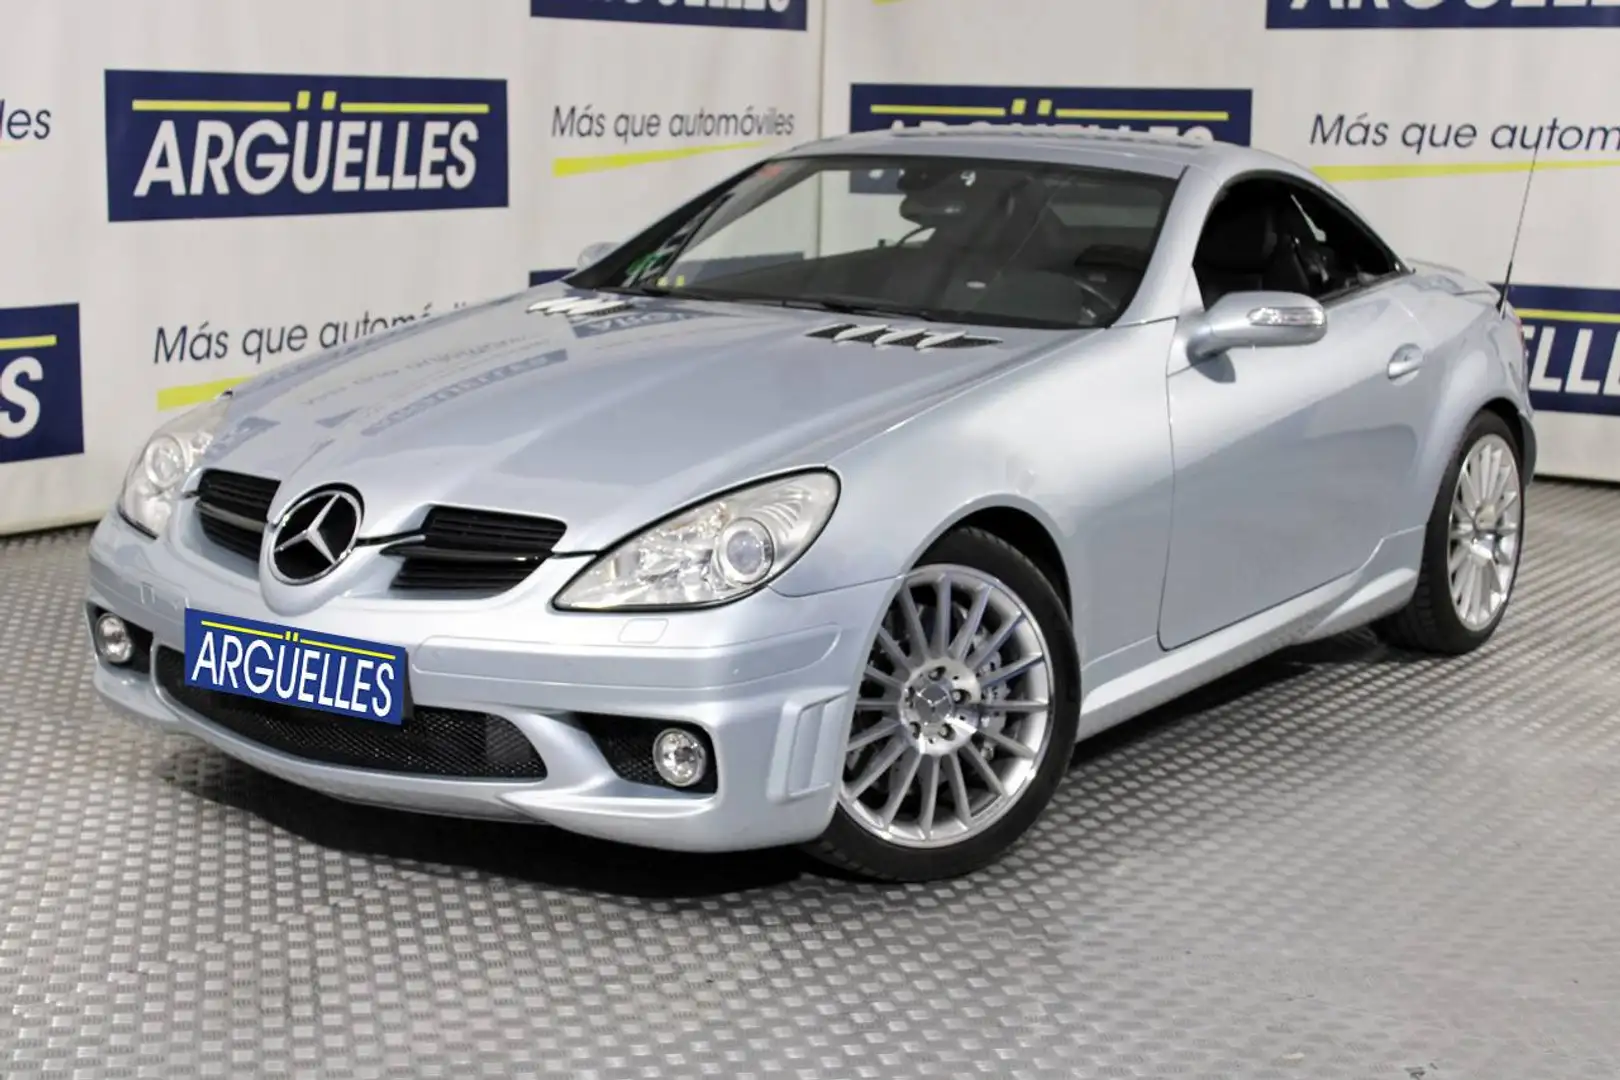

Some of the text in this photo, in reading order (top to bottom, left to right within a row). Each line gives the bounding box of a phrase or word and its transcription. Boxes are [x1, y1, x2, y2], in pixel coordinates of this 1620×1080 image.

[133, 91, 480, 197] ARGÜELLES
[551, 104, 795, 144] Más que automóviles
[1310, 112, 1389, 147] Más
[1401, 121, 1477, 155] que
[154, 311, 229, 364] Más
[242, 324, 308, 363] que
[191, 630, 395, 718] ARGÜELLES
